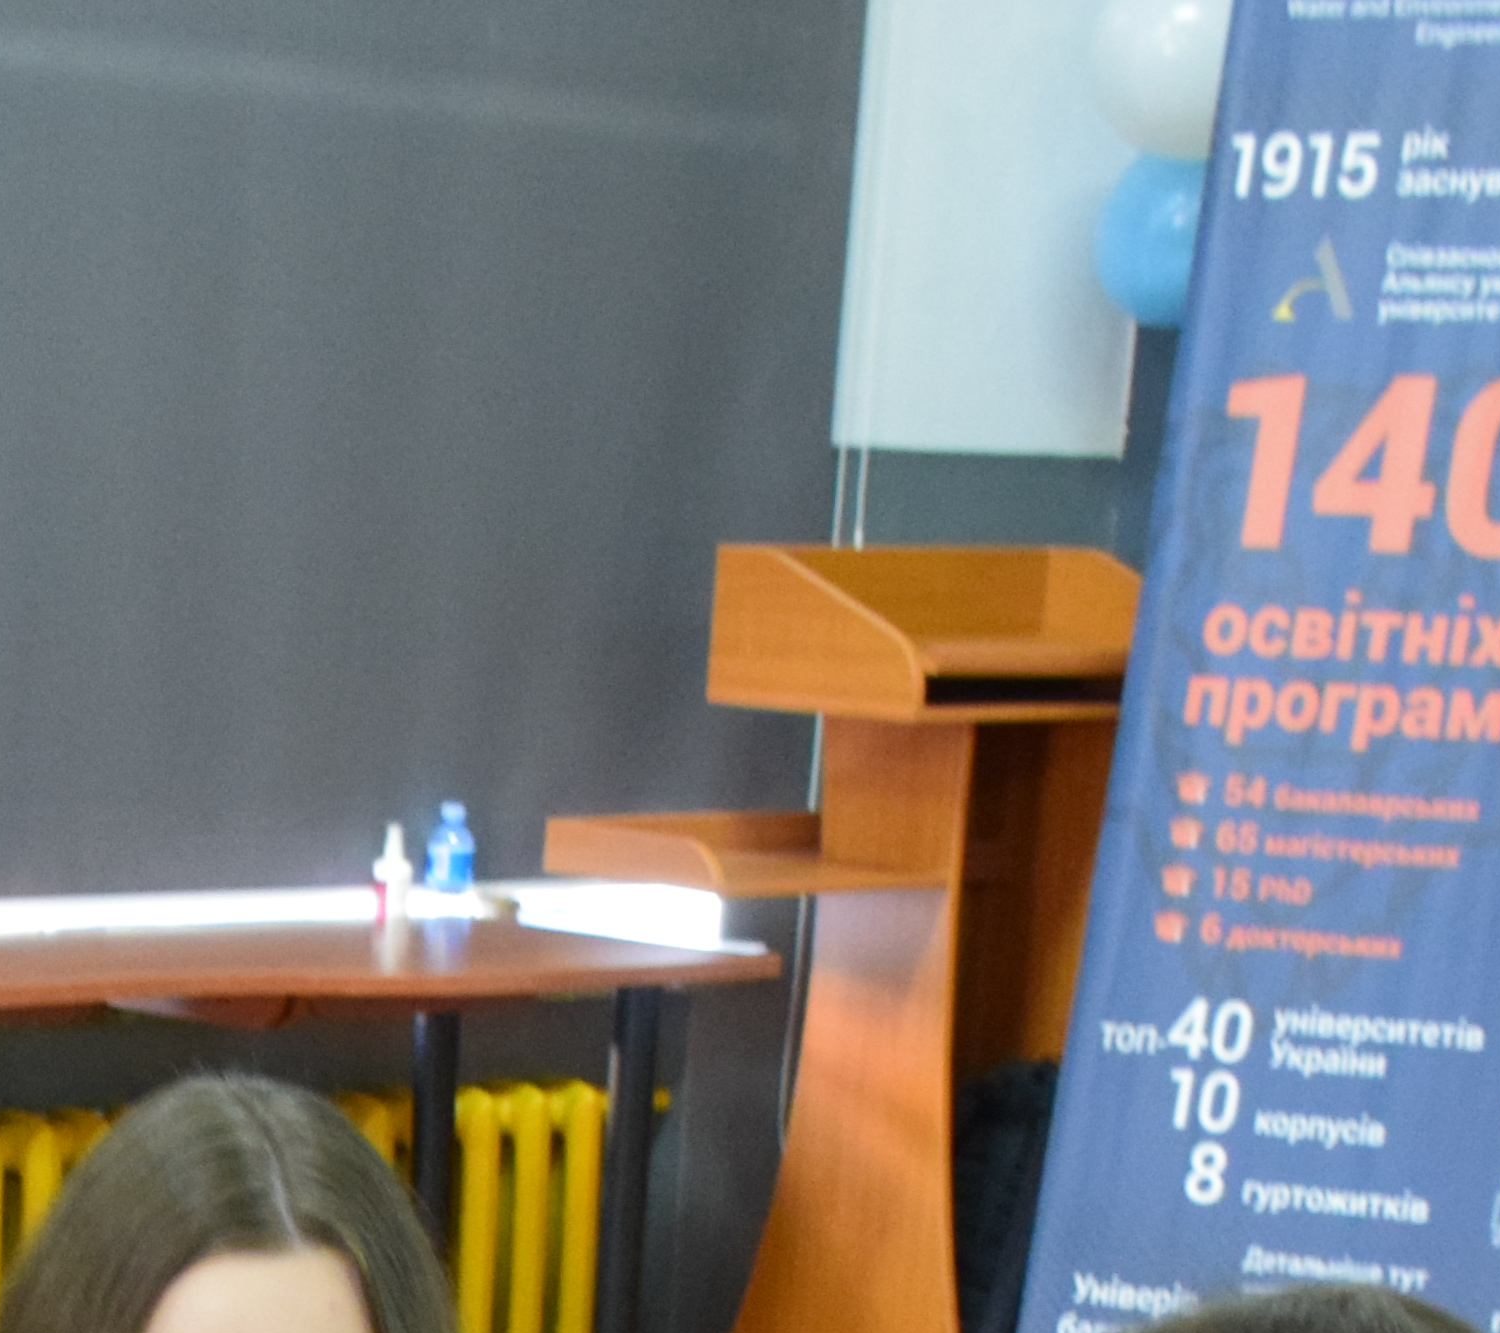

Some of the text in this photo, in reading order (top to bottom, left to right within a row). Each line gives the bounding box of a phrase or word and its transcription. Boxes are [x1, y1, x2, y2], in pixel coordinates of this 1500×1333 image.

[1230, 129, 1382, 200] 1915
[1400, 122, 1450, 165] рік
[1212, 863, 1314, 907] 15 PhD
[1200, 910, 1223, 947] 6
[1272, 1003, 1486, 1054] університетів
[1269, 1037, 1387, 1079] України
[1169, 1066, 1387, 1150] 10 корпусів
[1184, 1140, 1430, 1226] 8 гуртожитків
[1388, 1264, 1430, 1294] тут
